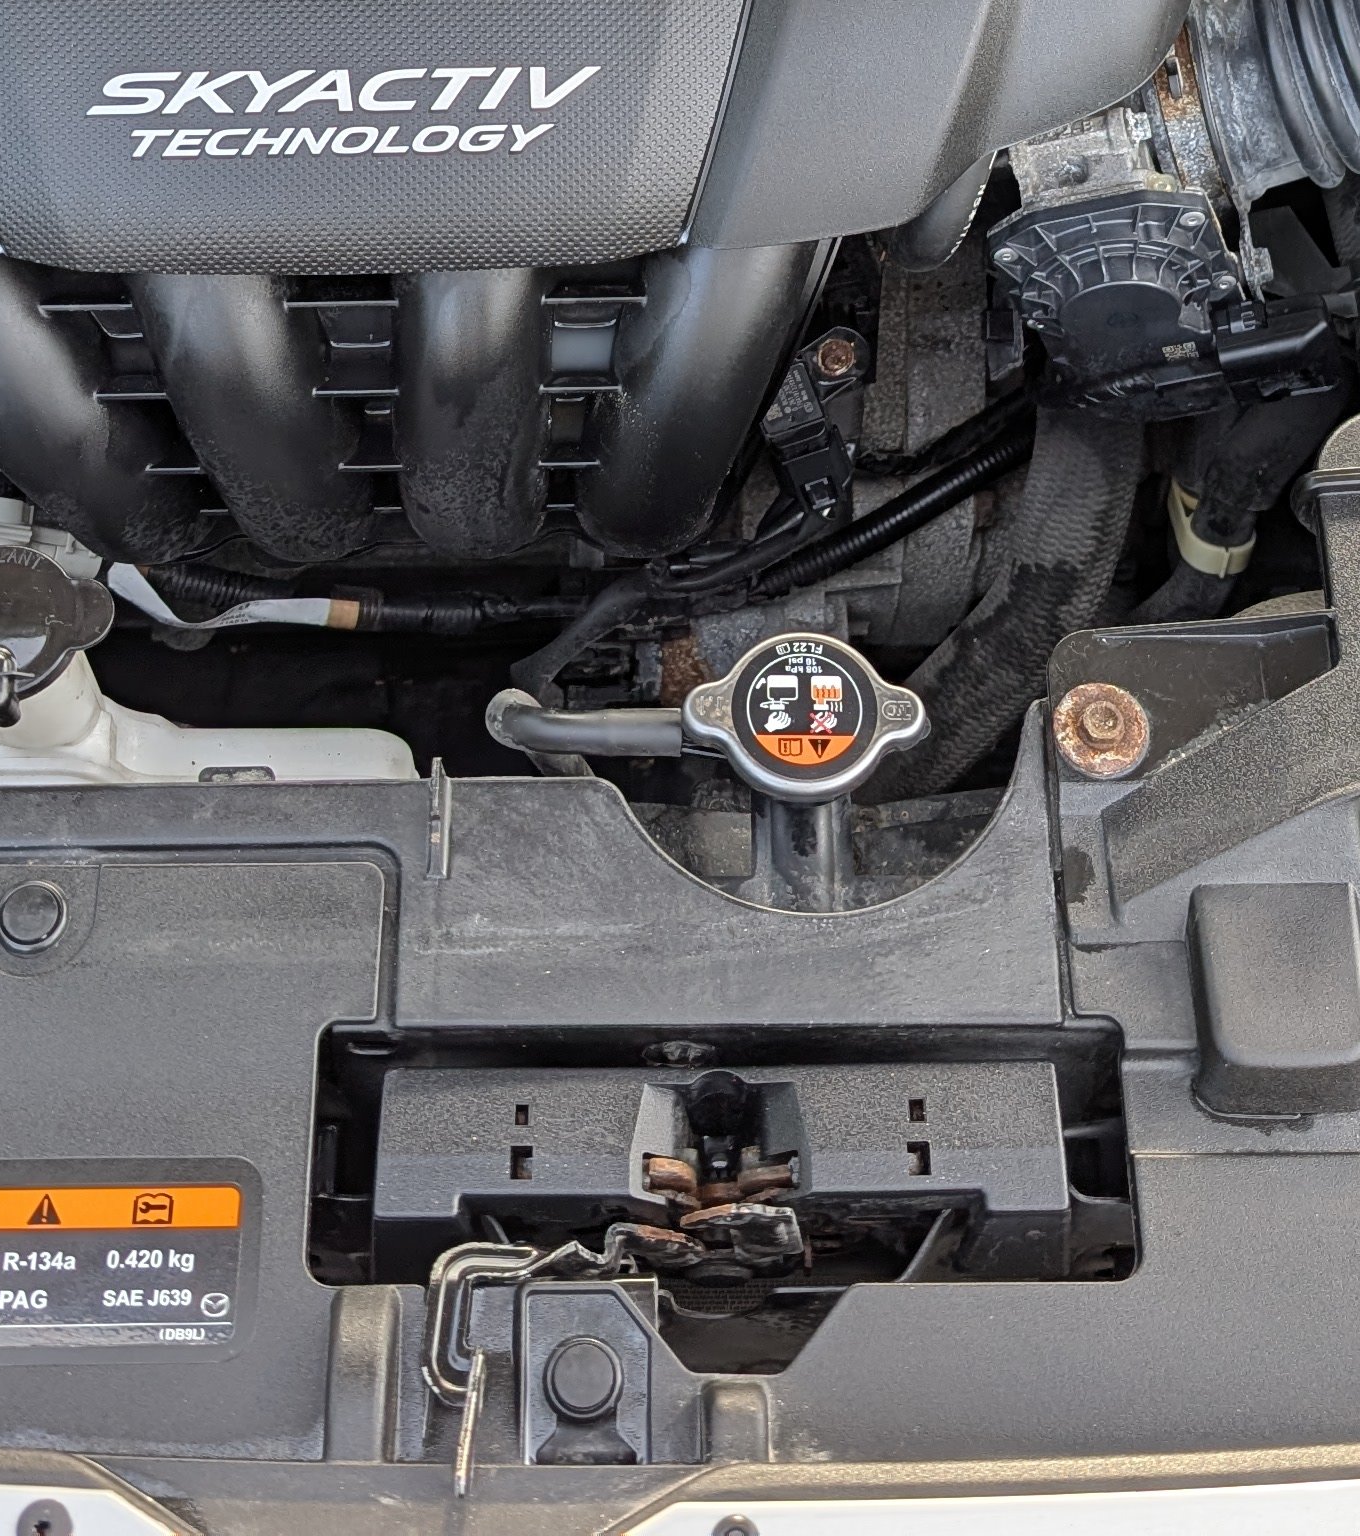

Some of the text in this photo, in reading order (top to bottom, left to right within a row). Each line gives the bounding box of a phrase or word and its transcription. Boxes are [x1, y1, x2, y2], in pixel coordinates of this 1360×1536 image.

[85, 65, 602, 116] SKYACTIV
[130, 123, 555, 159] TECHNOLOGY
[792, 642, 824, 655] FL22
[2, 1249, 195, 1273] R-134a 0.420 kg
[102, 1289, 144, 1307] SAE
[147, 1289, 192, 1307] J639
